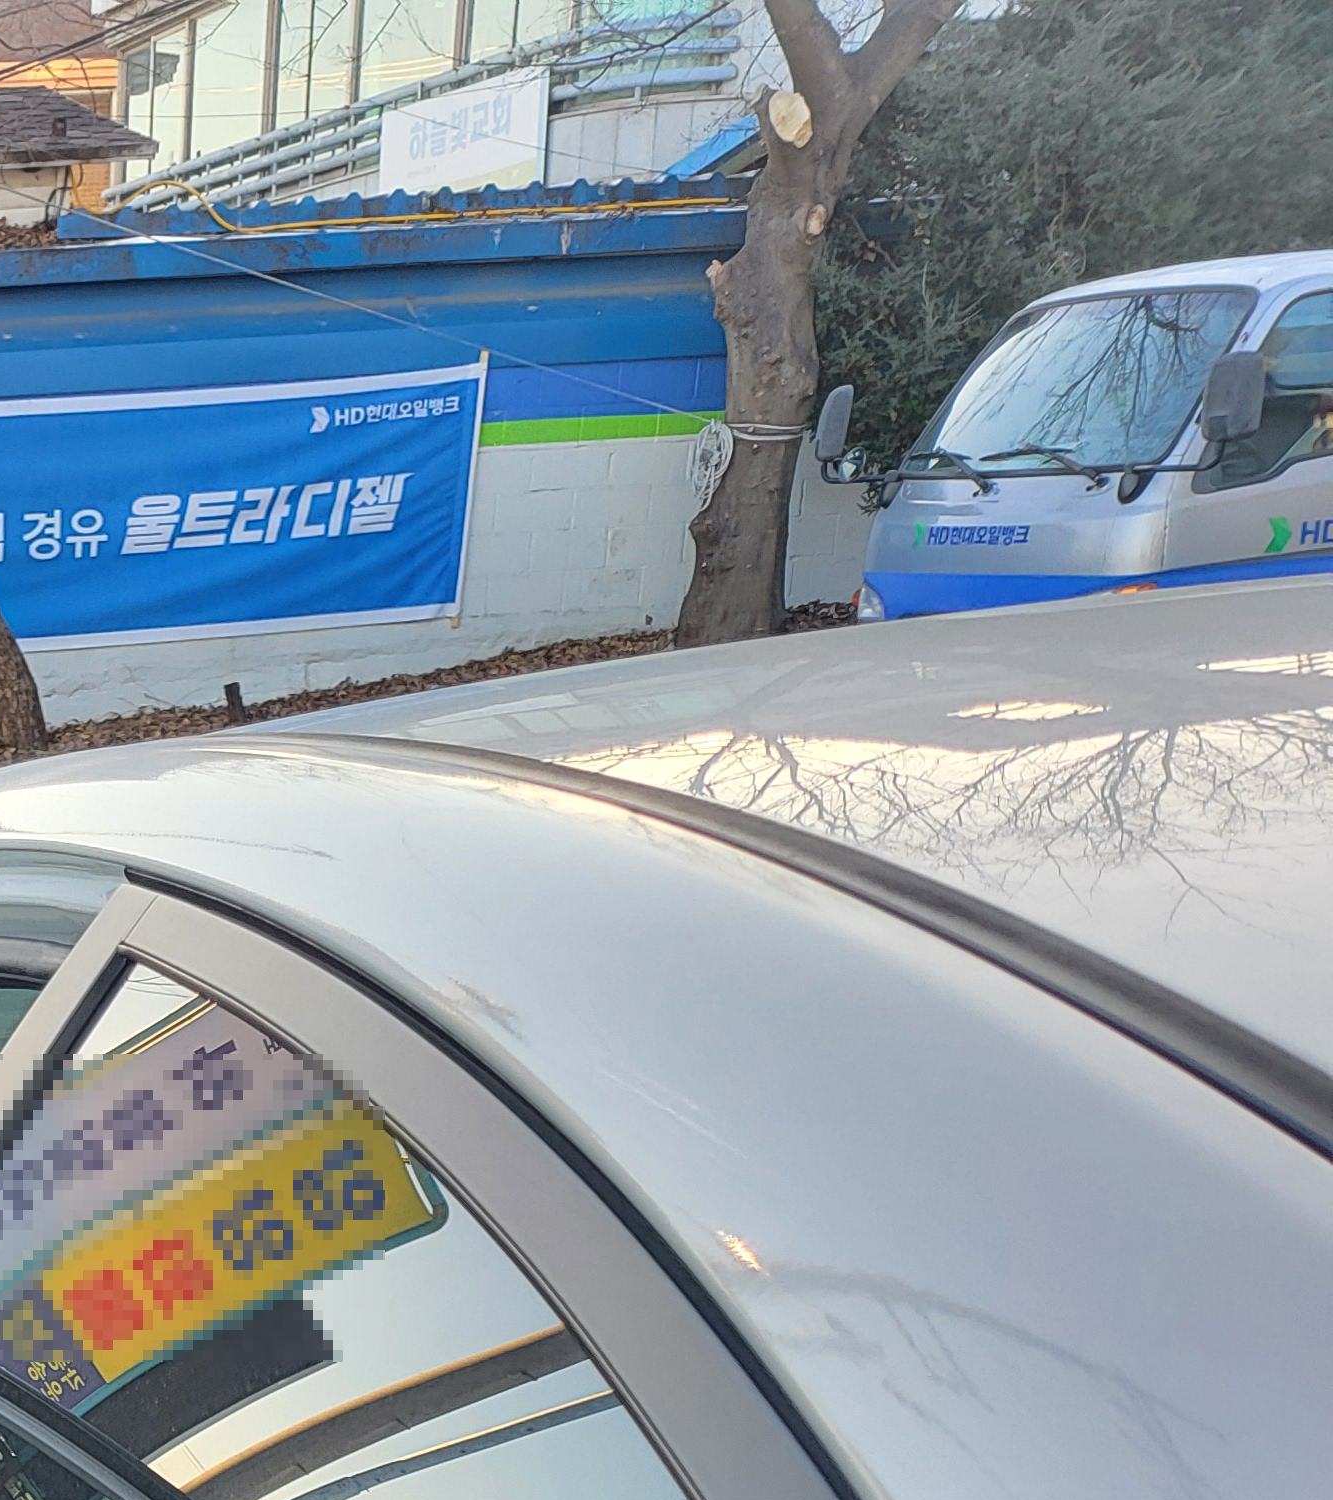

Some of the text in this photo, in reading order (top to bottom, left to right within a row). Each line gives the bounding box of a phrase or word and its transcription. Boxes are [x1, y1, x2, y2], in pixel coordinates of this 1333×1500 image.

[334, 395, 461, 428] HD현대오일뱅크
[22, 507, 109, 562] 경유
[120, 472, 414, 556] 울트라디젤
[926, 525, 1030, 546] HD현대오일뱅크
